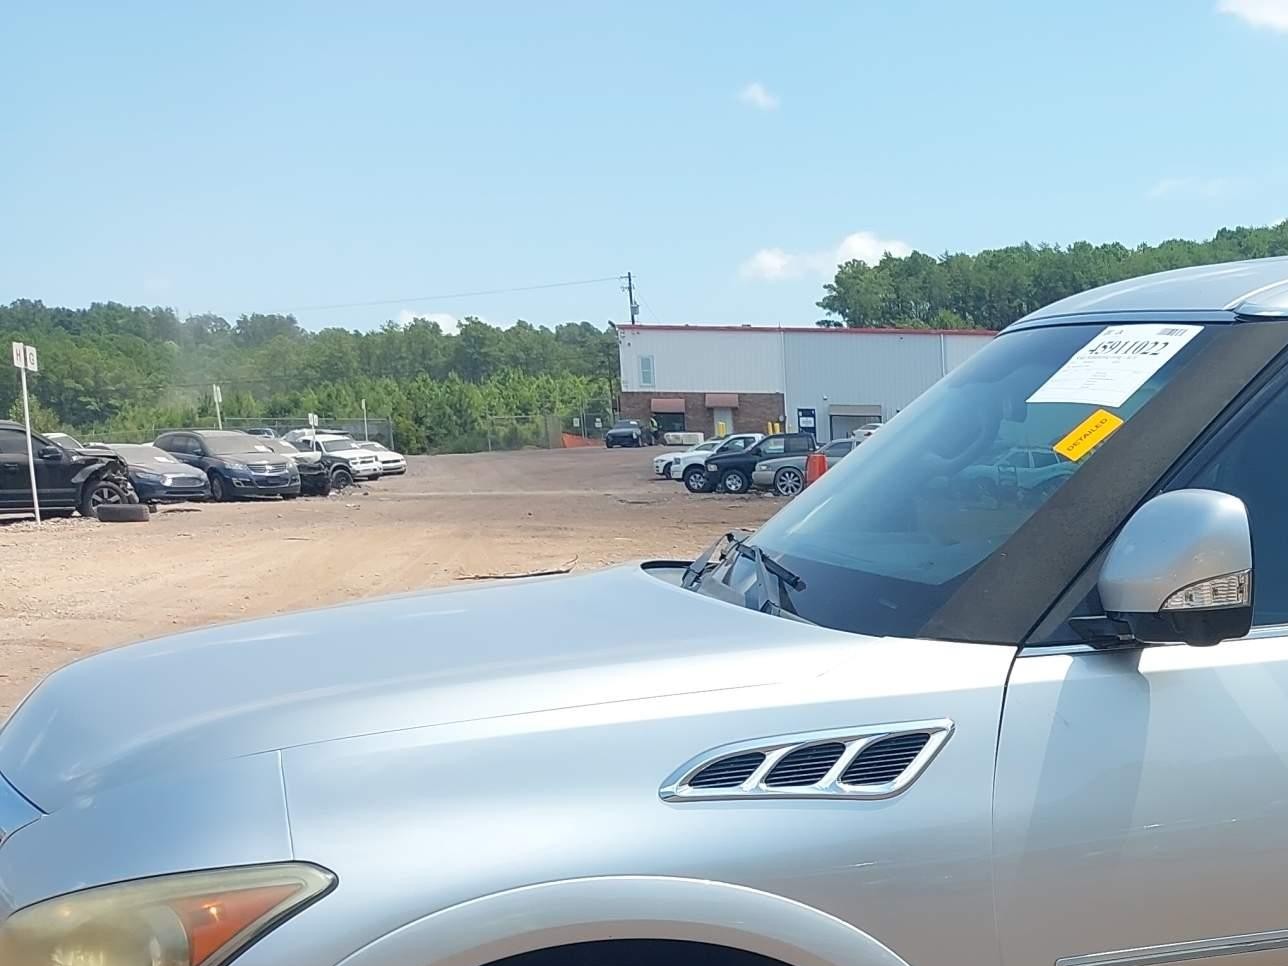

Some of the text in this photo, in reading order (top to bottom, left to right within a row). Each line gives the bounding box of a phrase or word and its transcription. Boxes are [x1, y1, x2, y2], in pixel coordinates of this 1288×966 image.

[1088, 340, 1169, 355] 45911022
[29, 352, 35, 365] G
[1066, 417, 1108, 452] DETAILED
